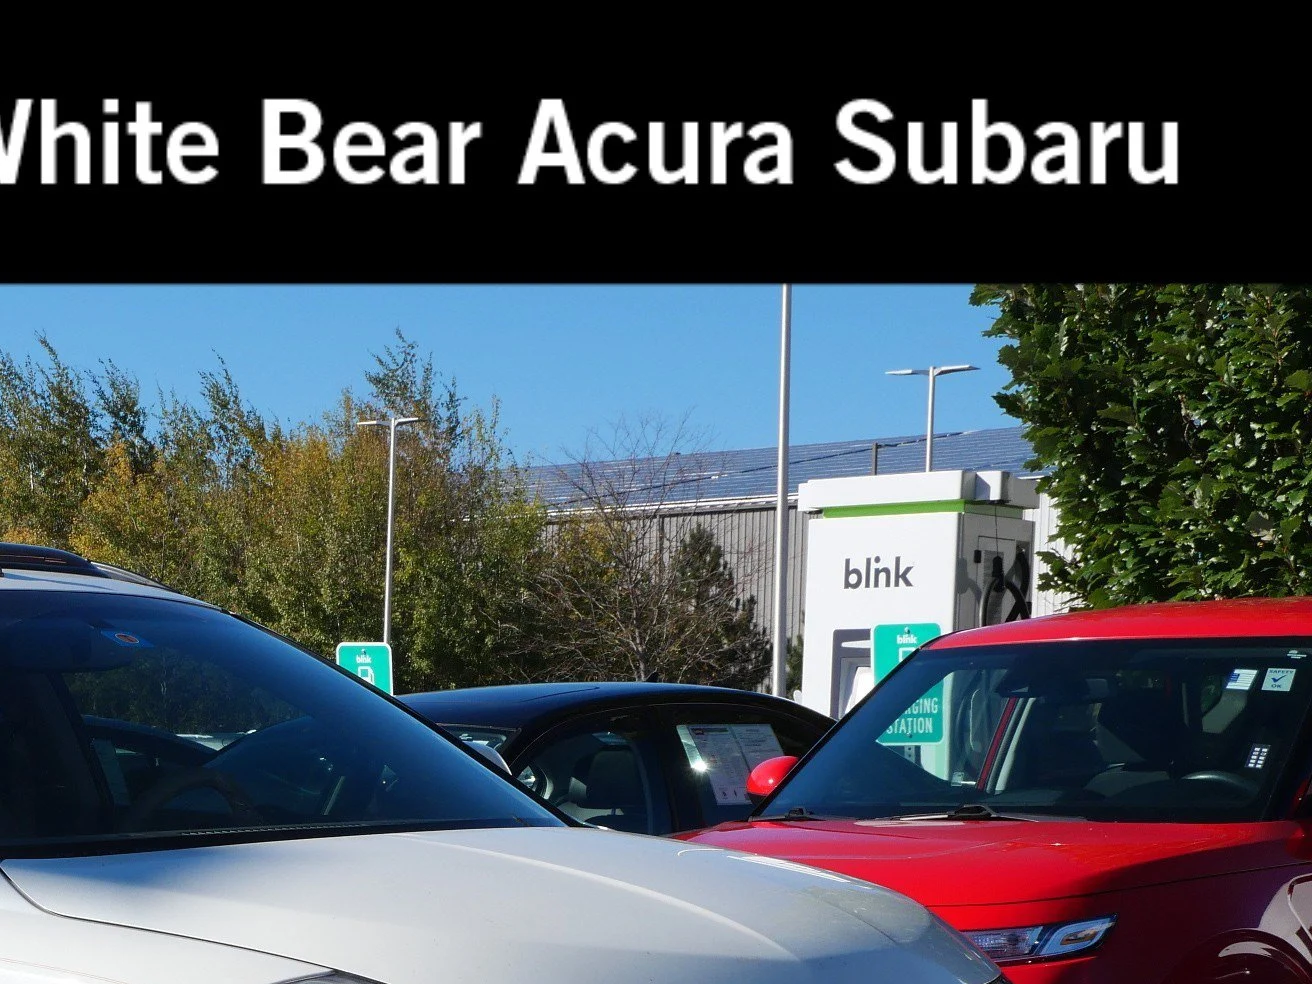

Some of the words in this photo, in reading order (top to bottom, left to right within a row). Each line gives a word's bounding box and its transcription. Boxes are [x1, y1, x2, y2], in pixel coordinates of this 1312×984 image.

[842, 555, 915, 590] blink
[896, 633, 918, 645] blink
[355, 653, 373, 664] blink
[886, 717, 933, 735] STATION
